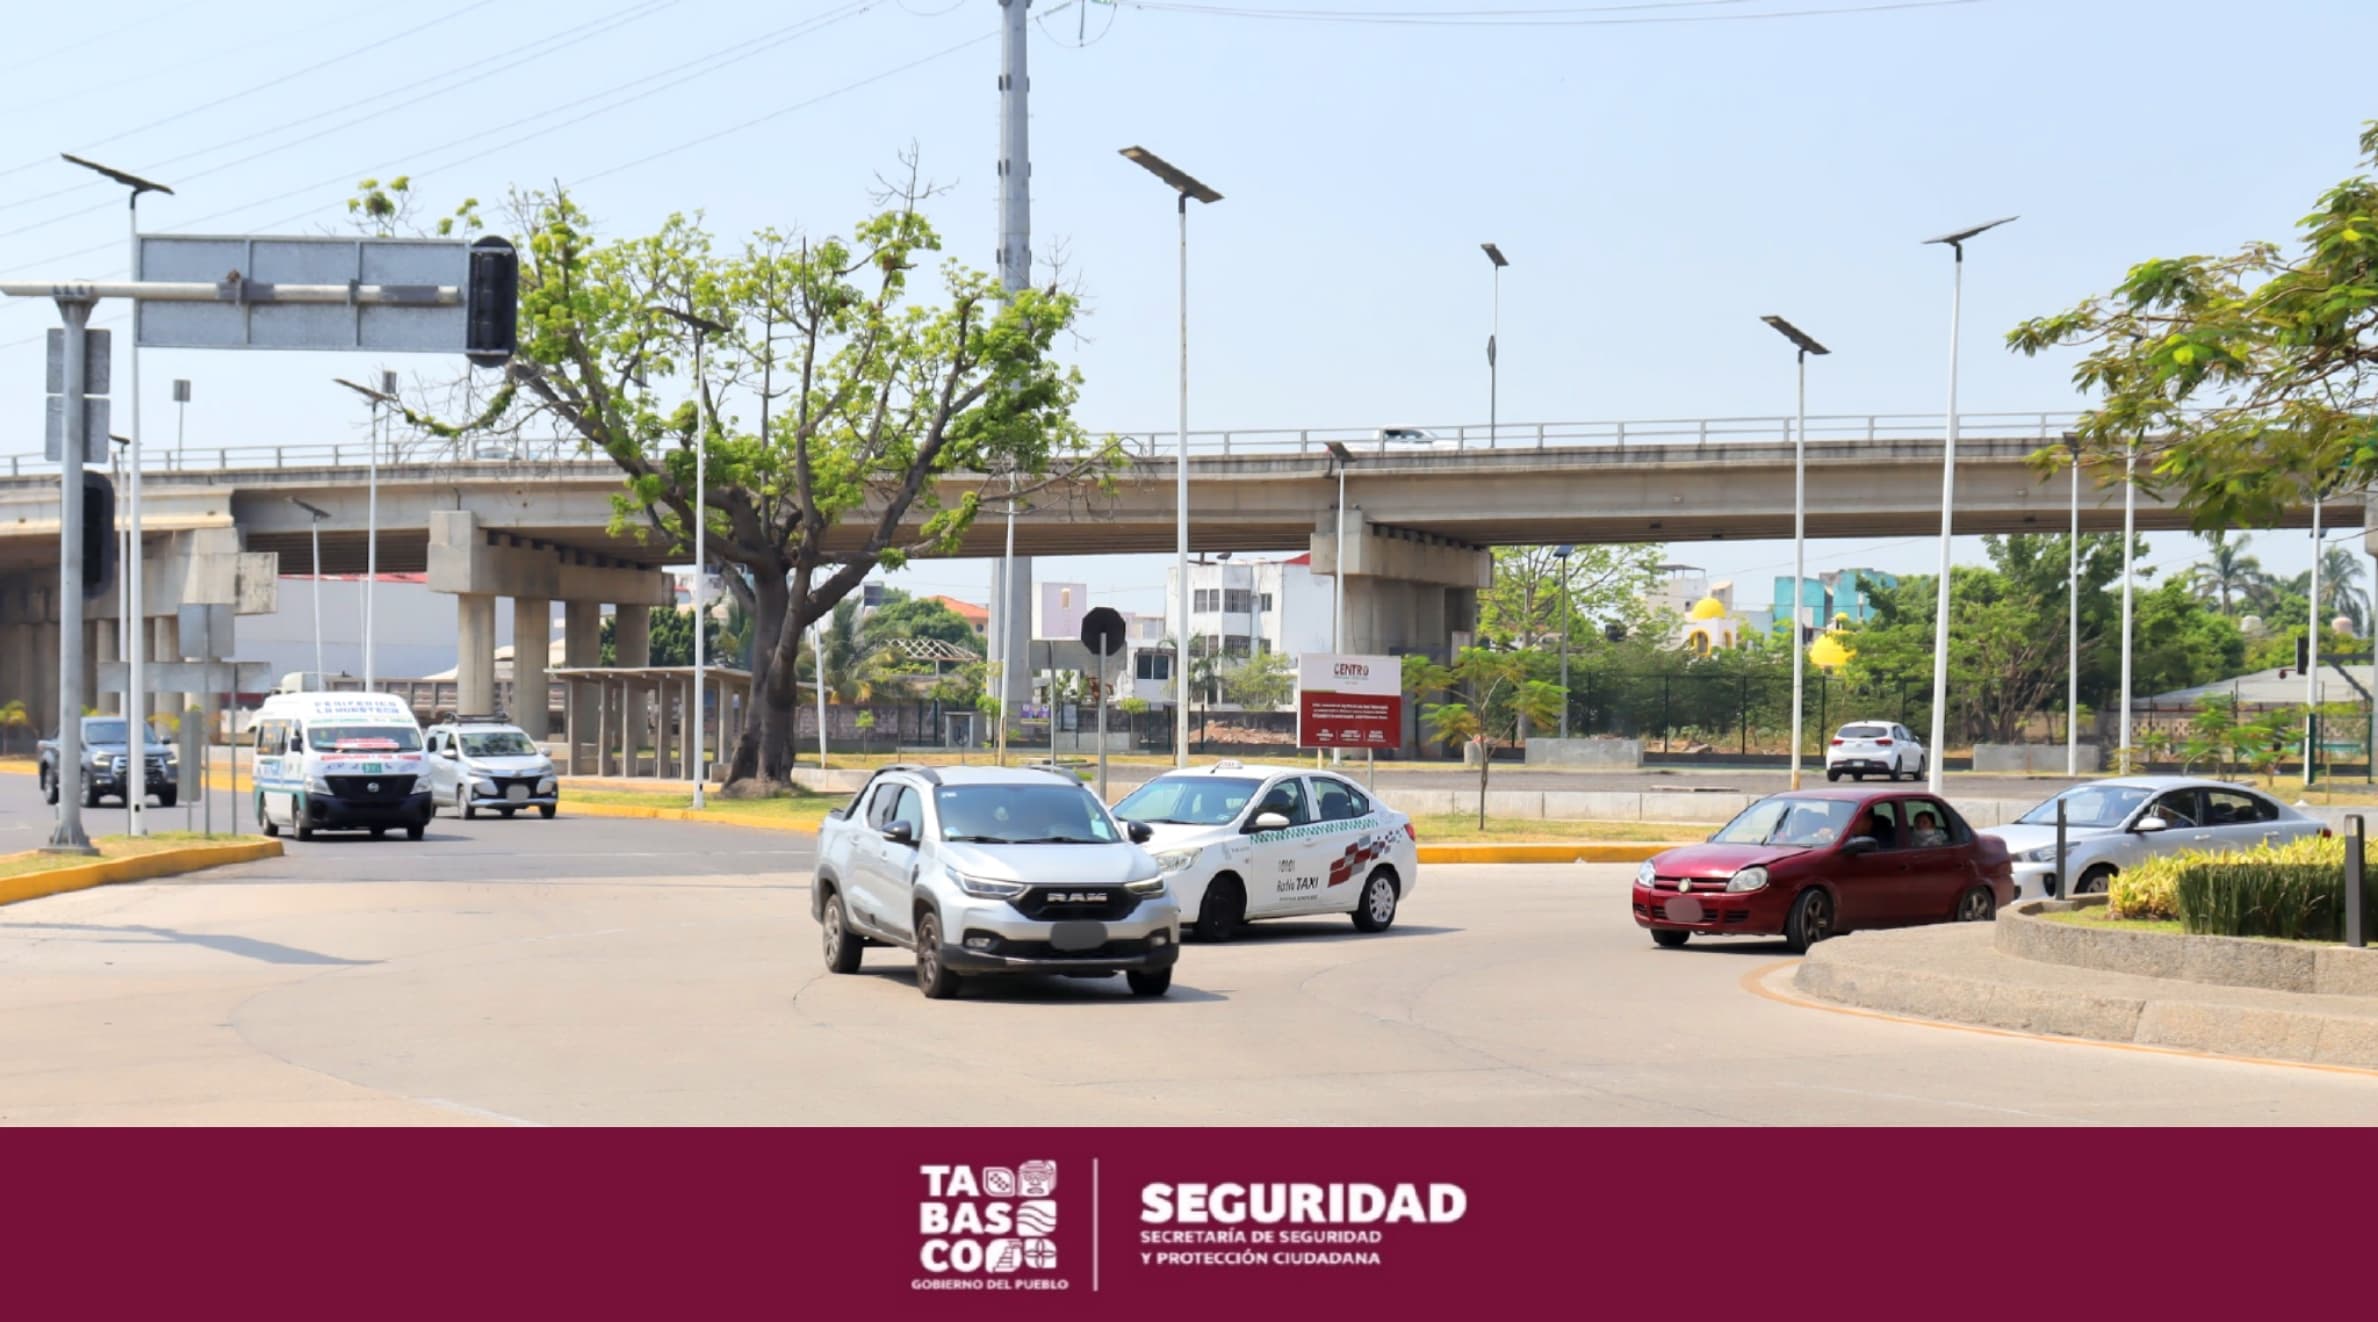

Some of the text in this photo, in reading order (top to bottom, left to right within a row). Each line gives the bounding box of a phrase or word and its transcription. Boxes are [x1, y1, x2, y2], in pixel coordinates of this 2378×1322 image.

[1333, 663, 1369, 676] CENTRO
[1296, 876, 1319, 891] TAXI
[1047, 892, 1108, 902] RAM
